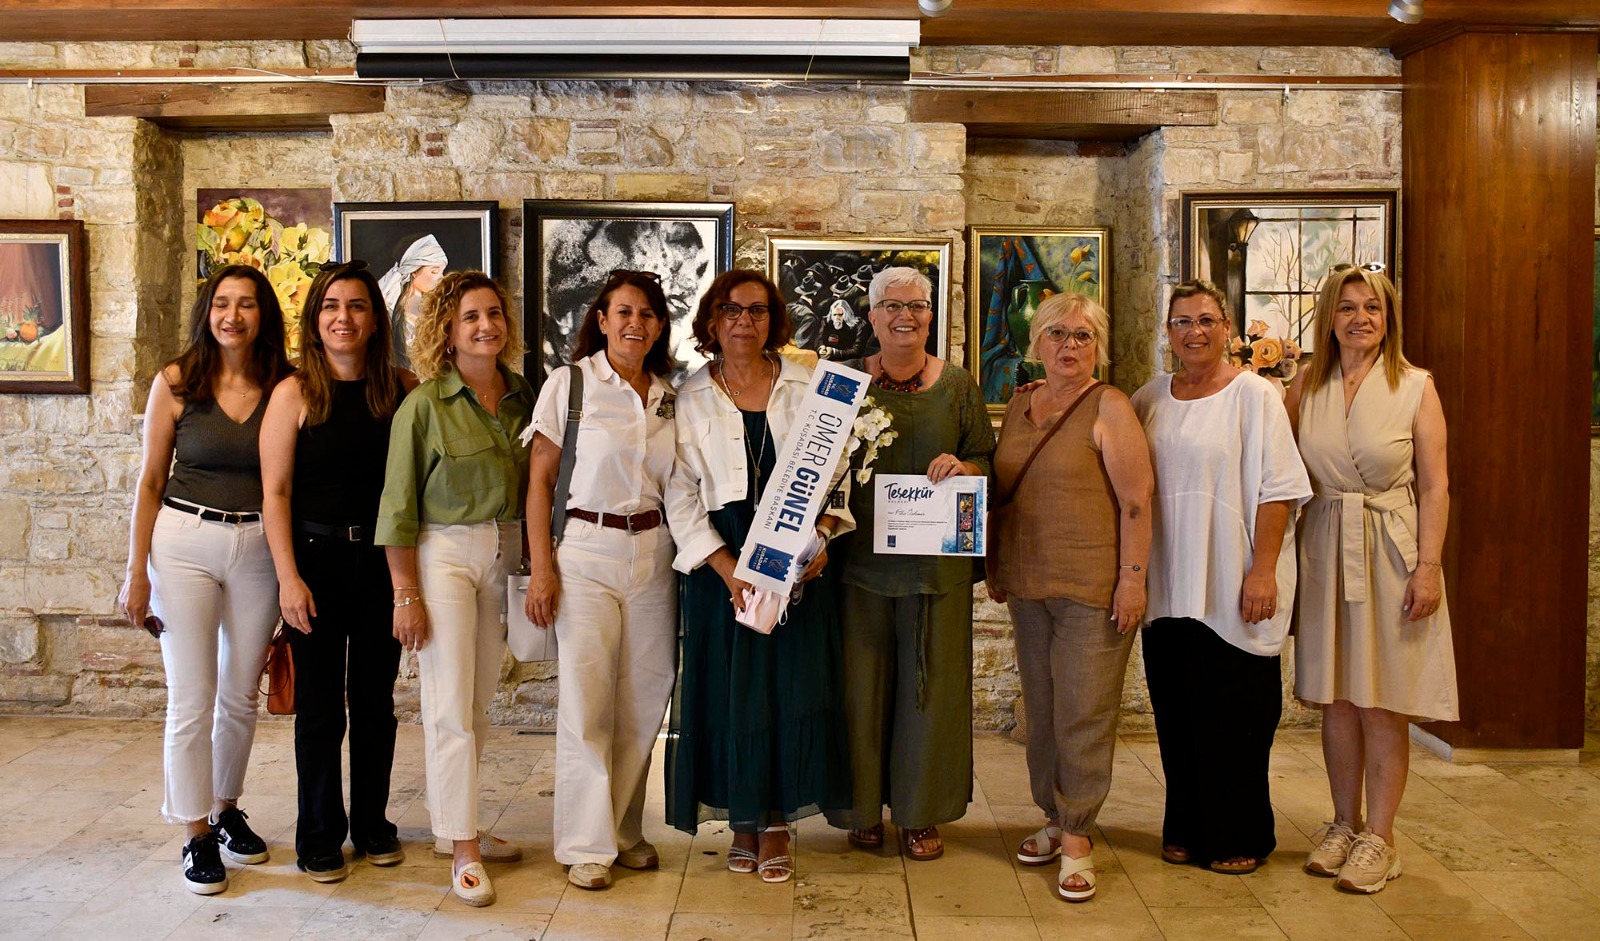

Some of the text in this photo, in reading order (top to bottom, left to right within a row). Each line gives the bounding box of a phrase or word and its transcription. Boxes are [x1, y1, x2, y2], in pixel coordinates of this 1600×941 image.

[808, 408, 817, 420] T.C.
[792, 422, 811, 459] KUŞADASI
[774, 412, 842, 532] ÖMER GÜNEL
[763, 496, 781, 530] BAŞKANI
